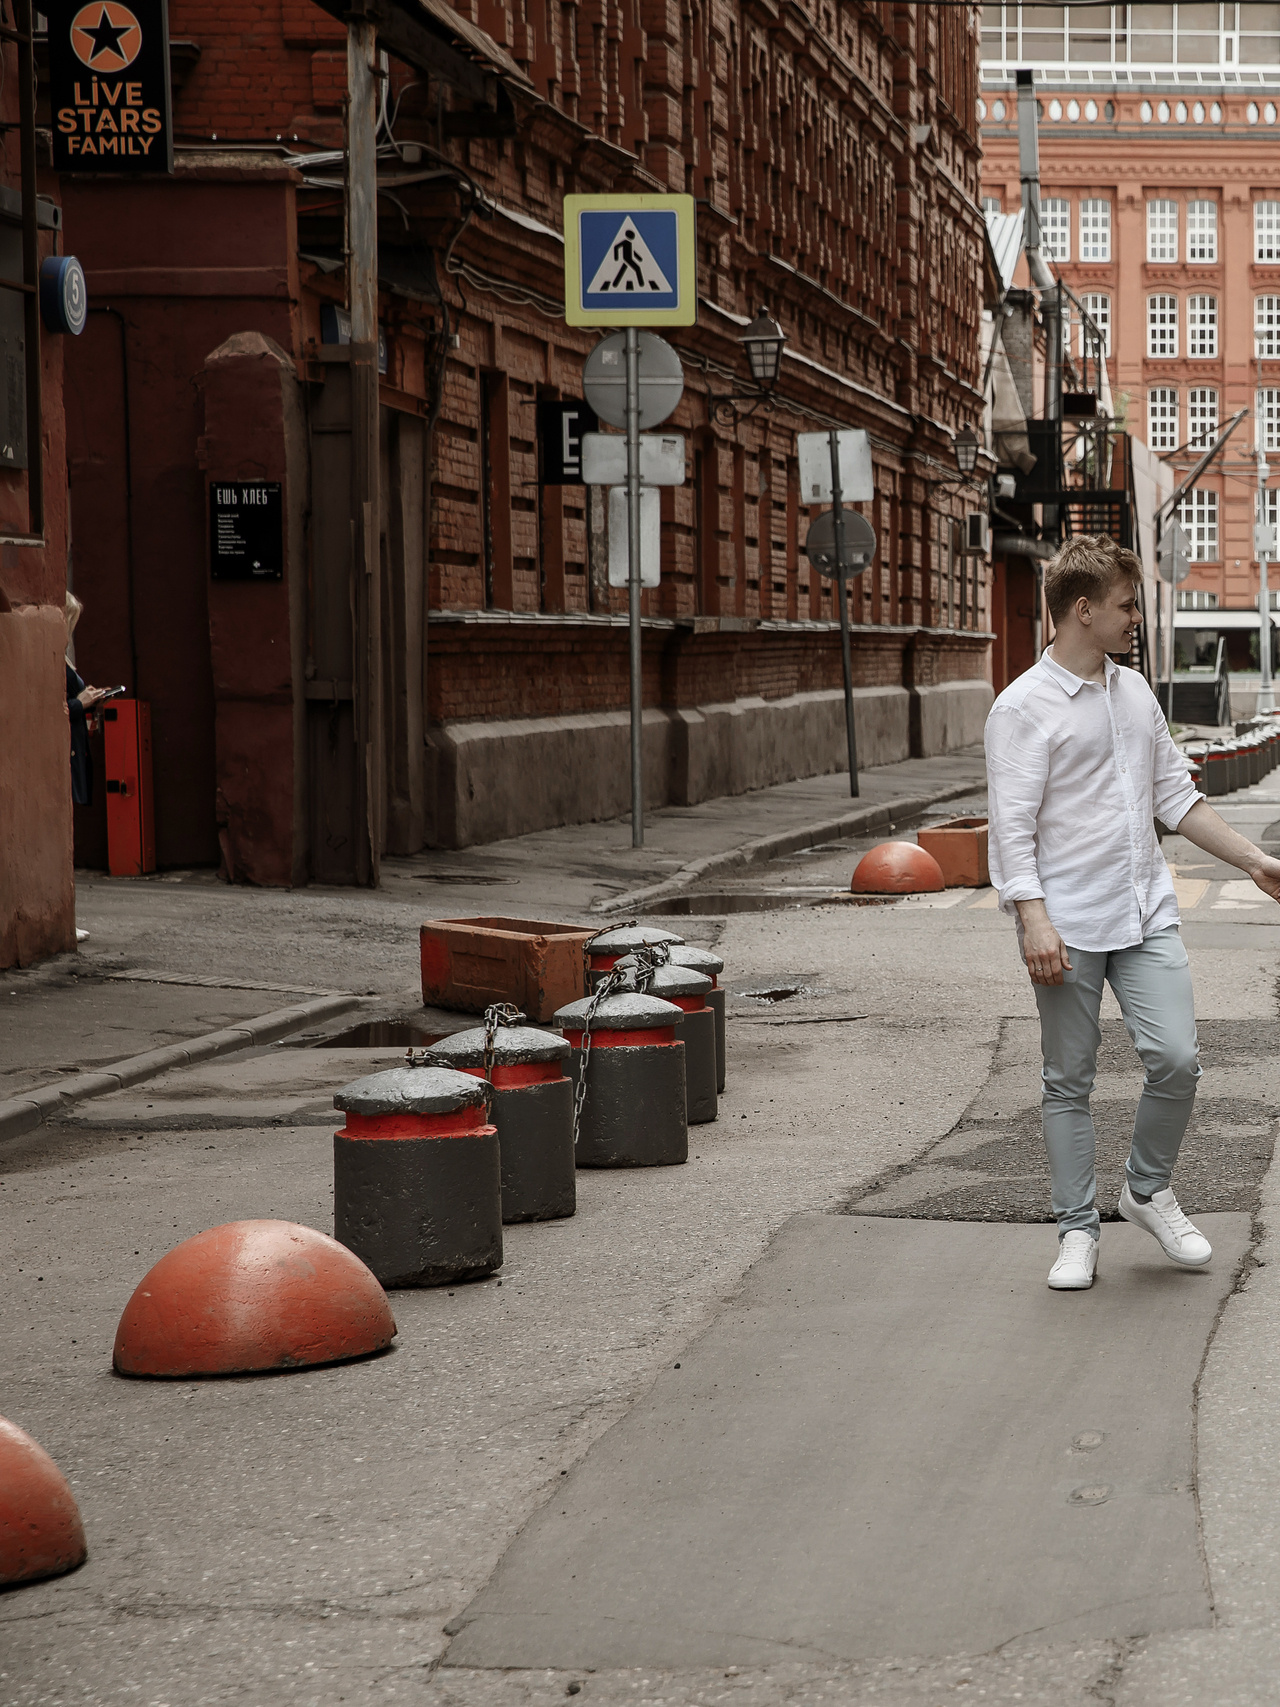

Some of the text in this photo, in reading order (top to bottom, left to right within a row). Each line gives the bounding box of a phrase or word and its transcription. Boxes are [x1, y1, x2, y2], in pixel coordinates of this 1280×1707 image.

[57, 108, 162, 133] STARS
[68, 136, 154, 155] FAMILY
[72, 272, 79, 305] 5
[217, 488, 268, 505] ЕШЬ ХЛЕБ
